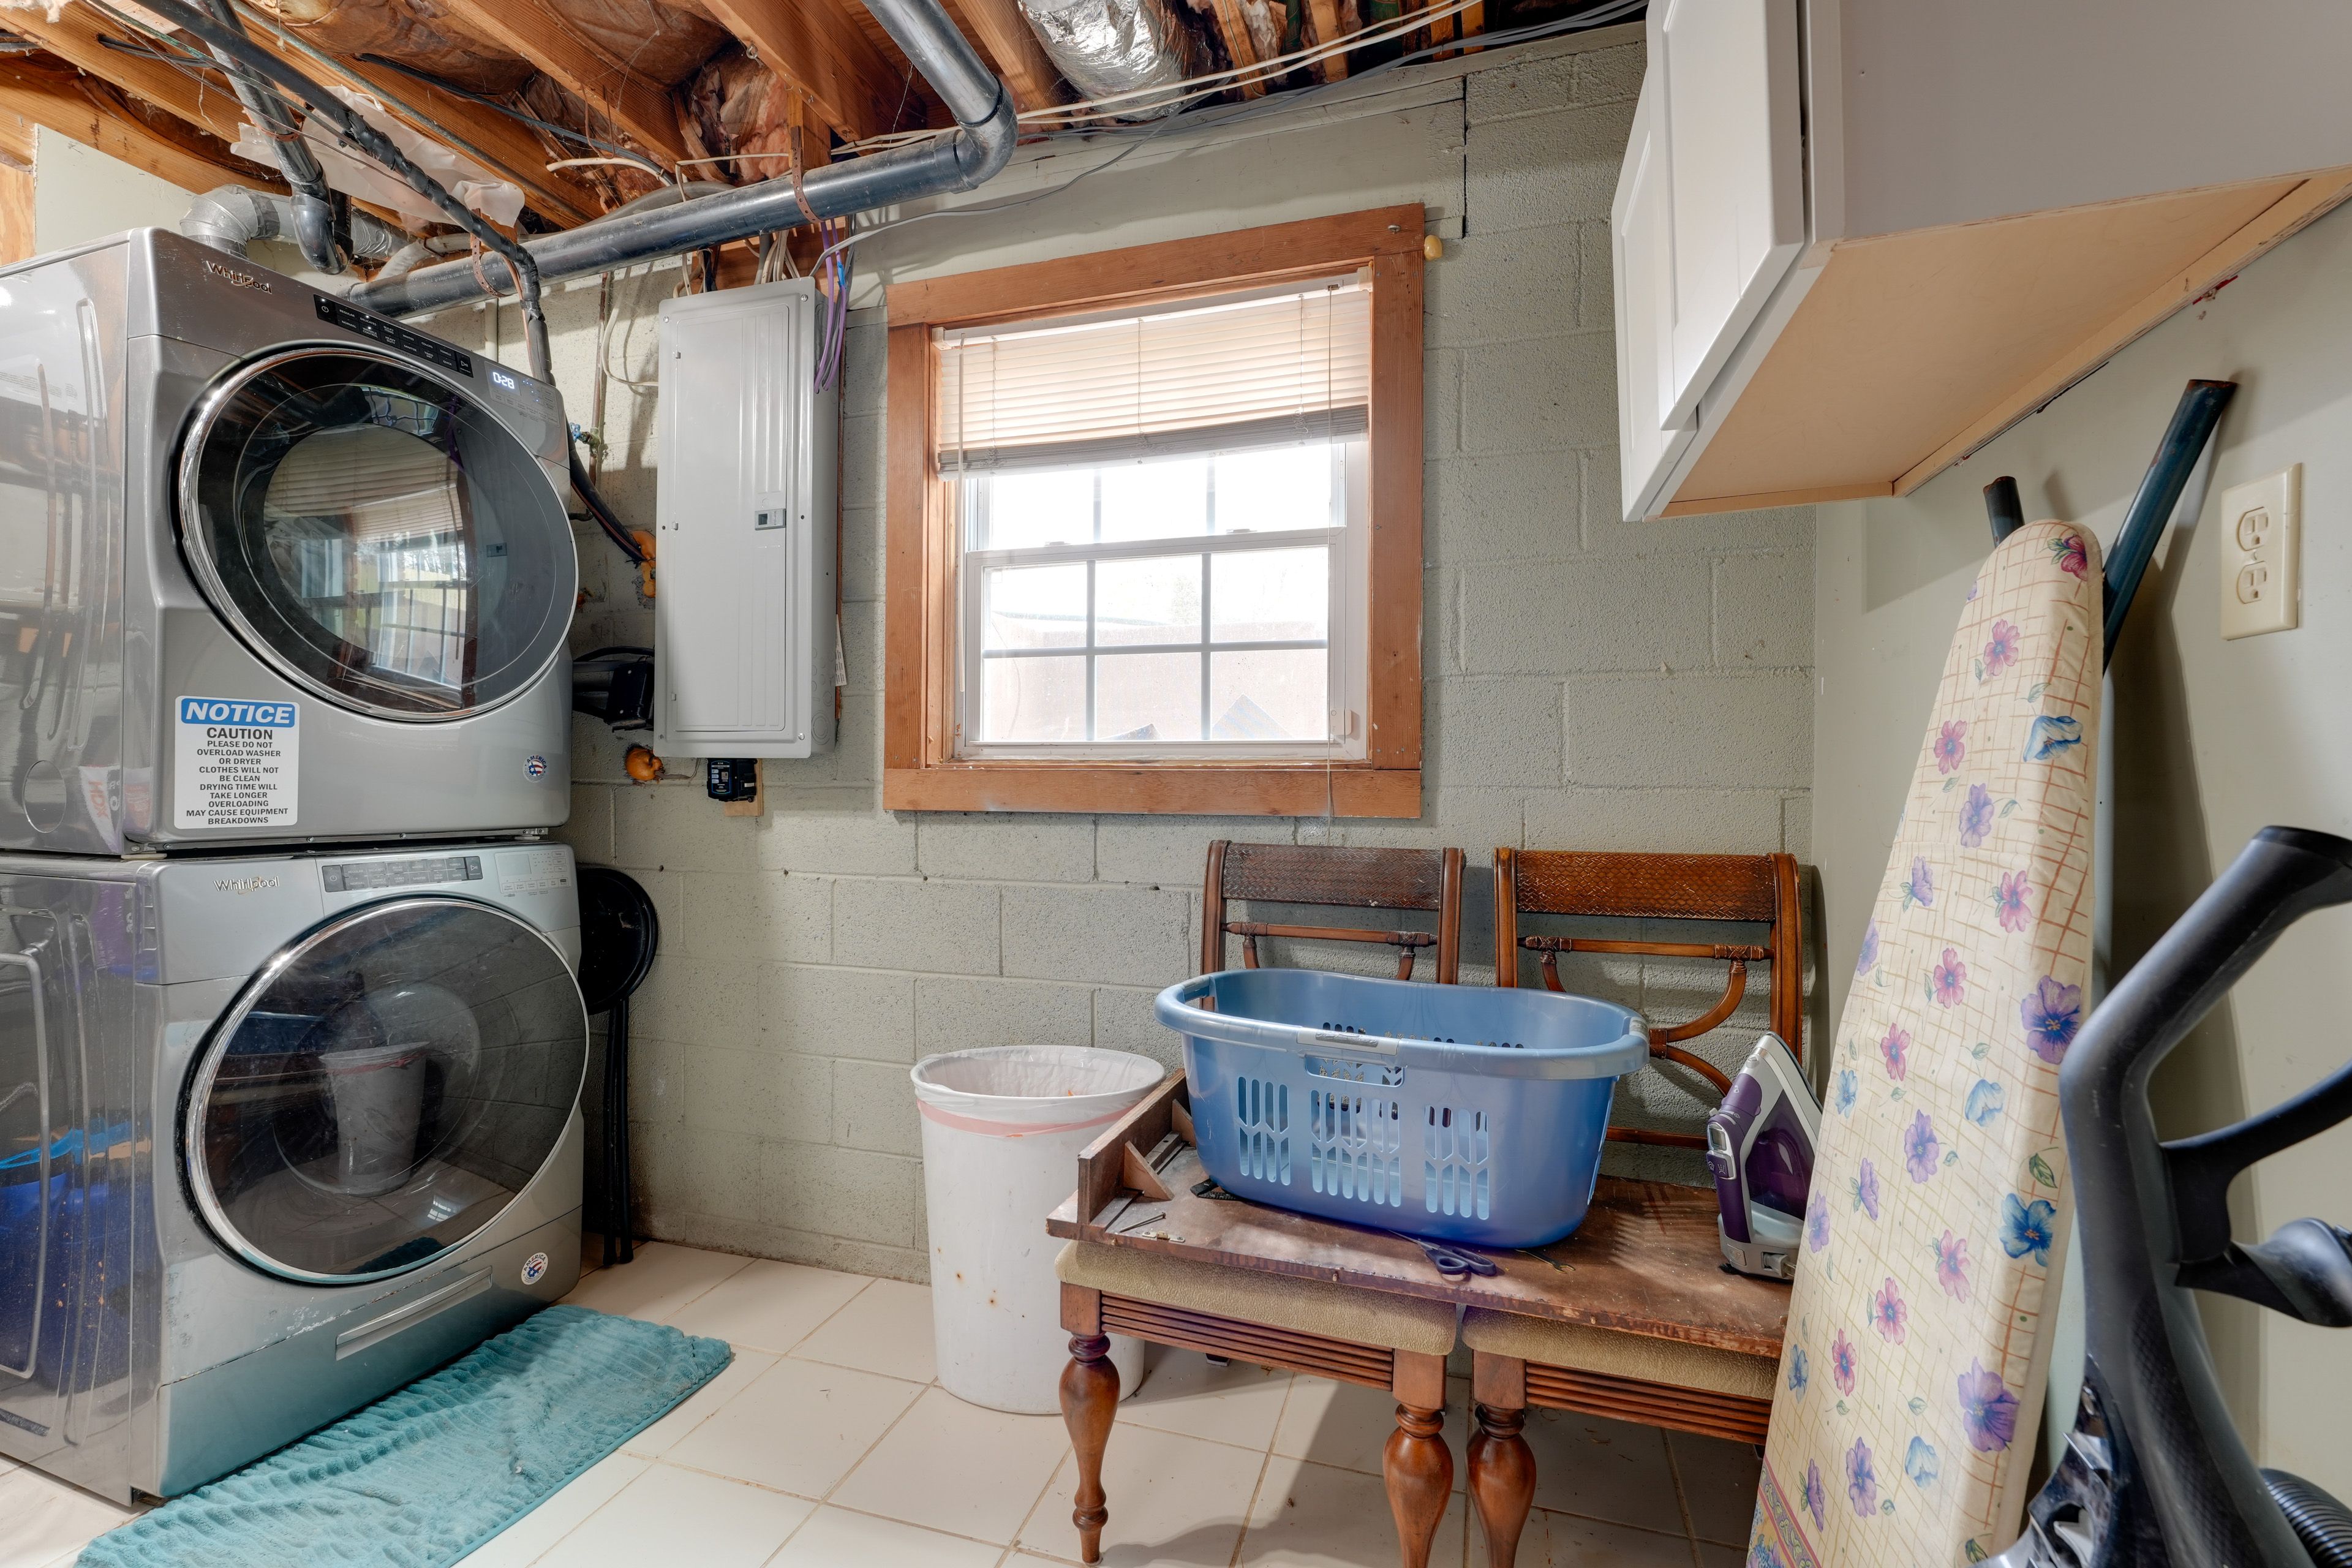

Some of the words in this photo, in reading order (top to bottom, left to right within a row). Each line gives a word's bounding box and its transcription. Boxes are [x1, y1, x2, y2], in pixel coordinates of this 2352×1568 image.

[206, 260, 273, 295] Whirlpool
[360, 317, 377, 326] DELICATES
[492, 372, 515, 390] 0:28
[186, 702, 292, 723] NOTICE
[207, 728, 273, 739] CAUTION
[527, 755, 547, 769] AMERICA
[213, 875, 279, 893] Whirlpool
[523, 1254, 546, 1272] AMERICA
